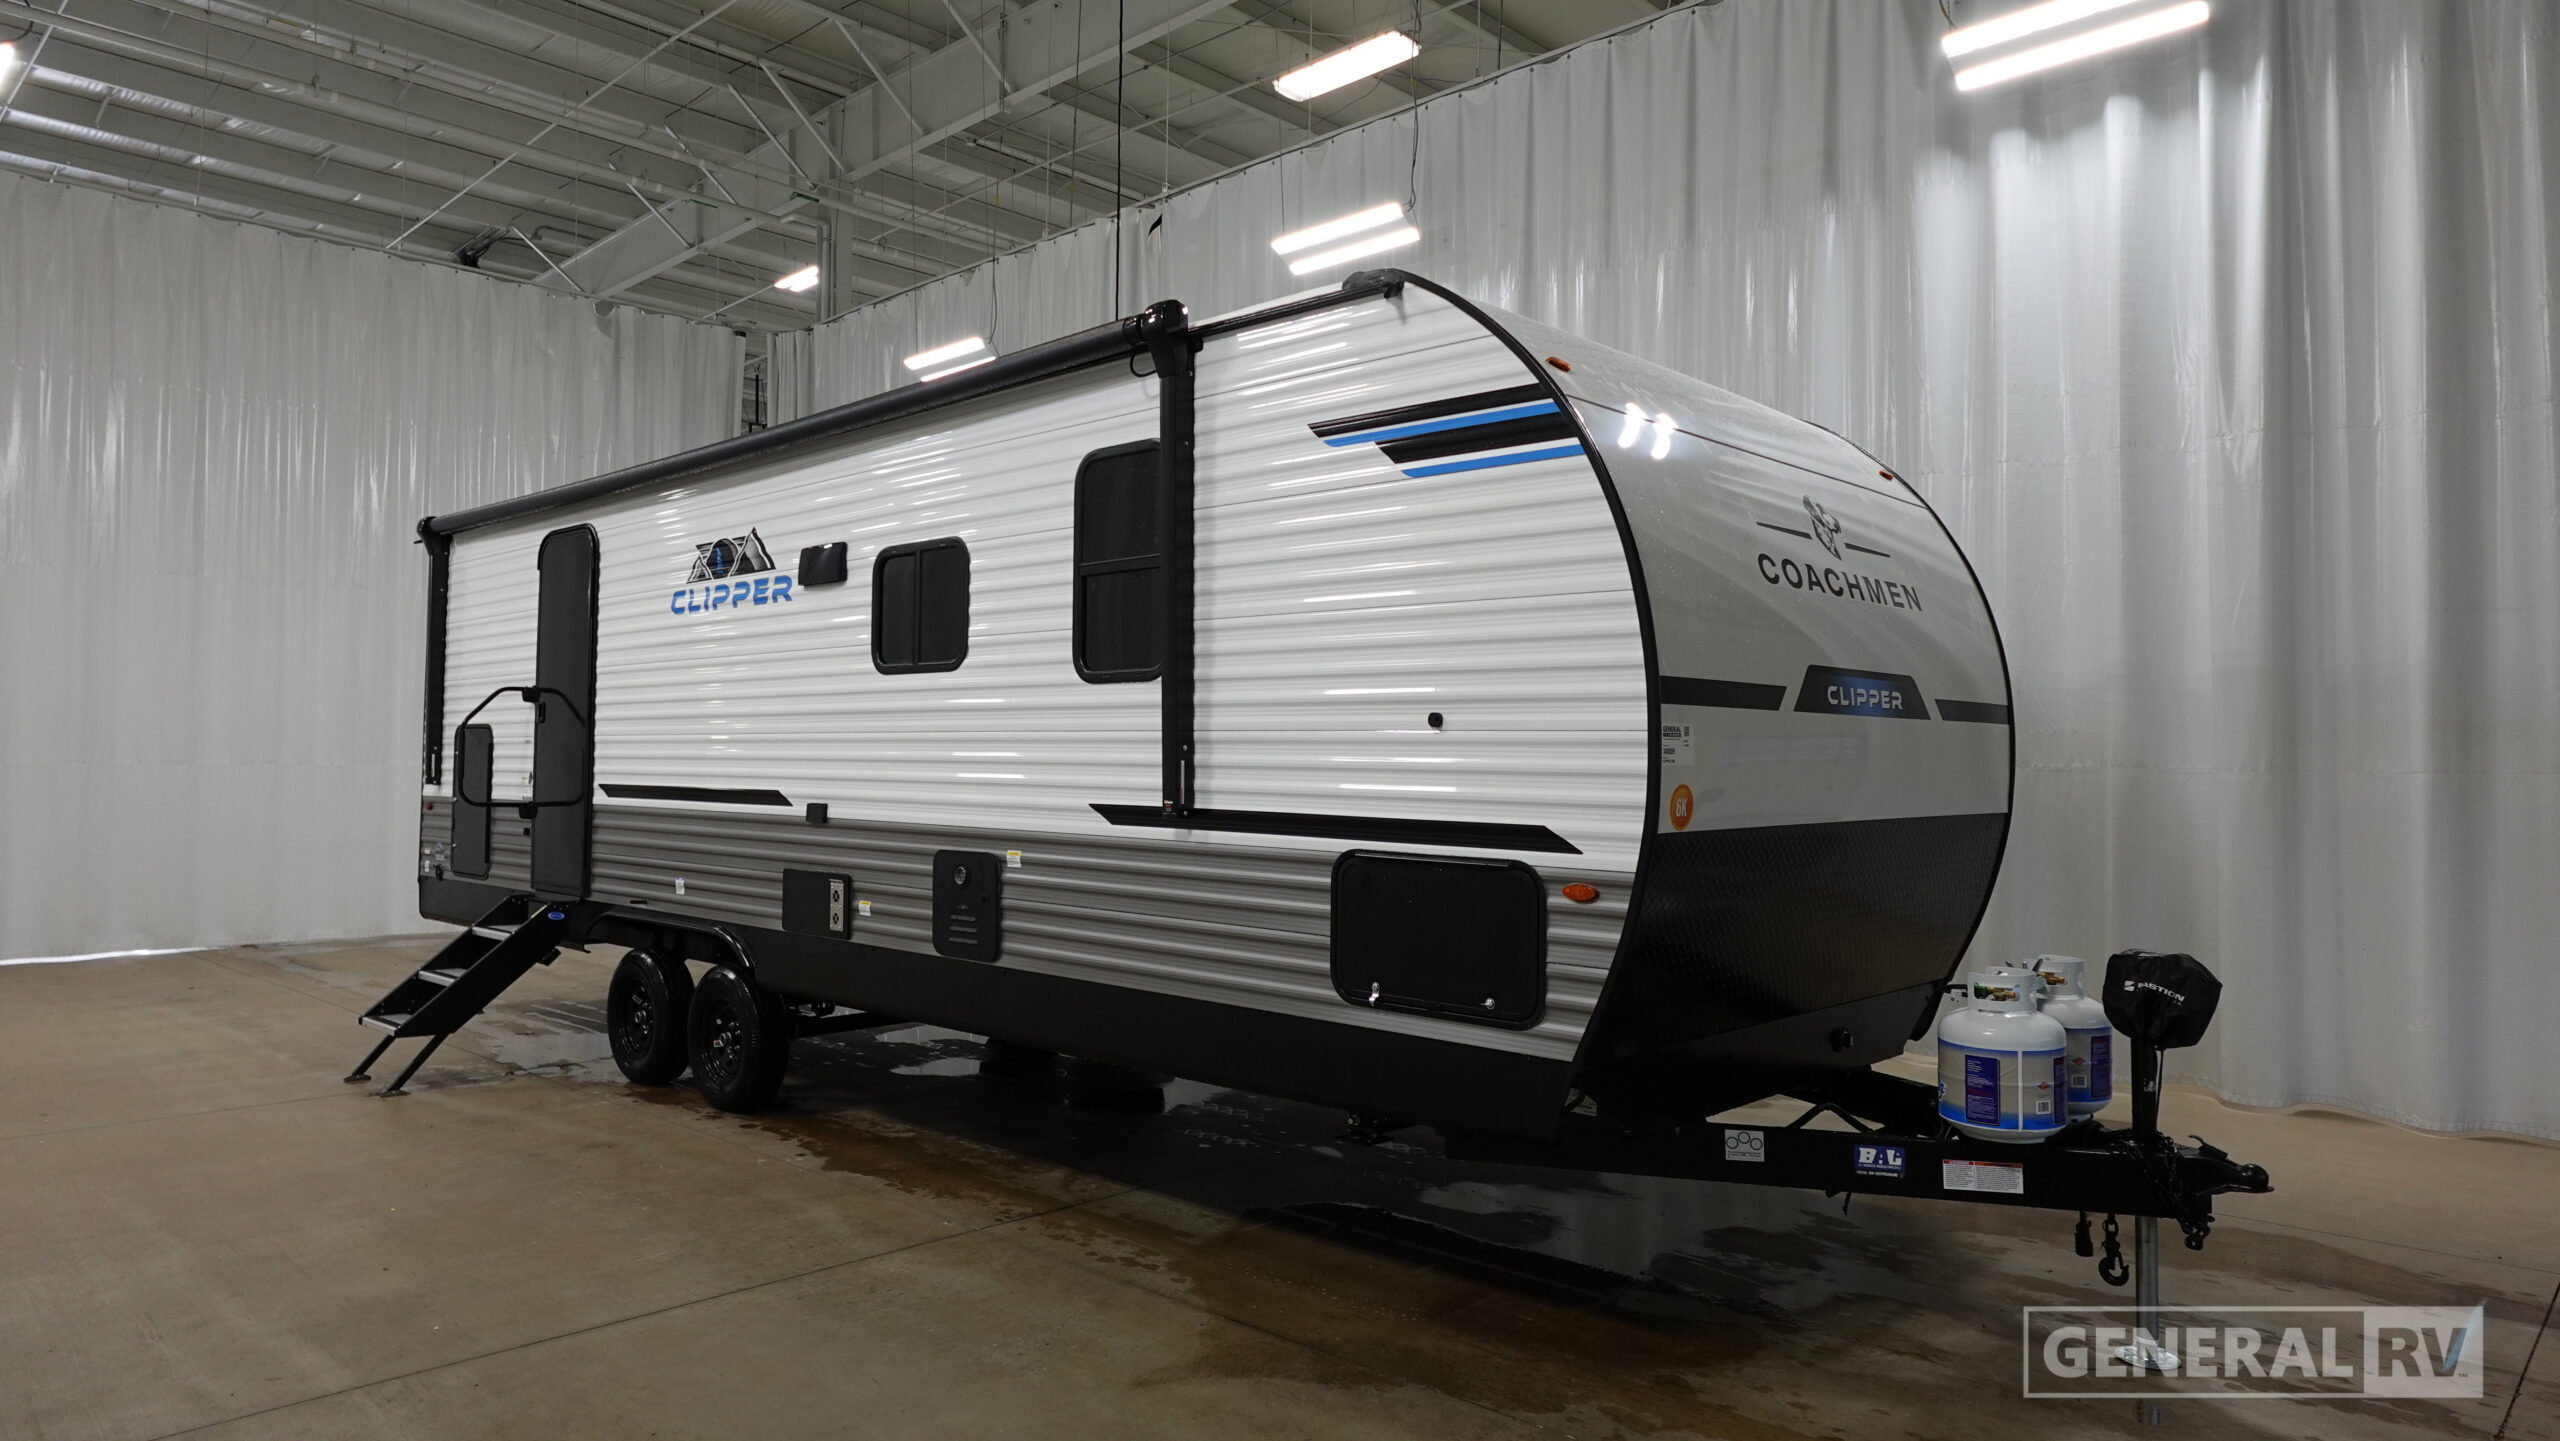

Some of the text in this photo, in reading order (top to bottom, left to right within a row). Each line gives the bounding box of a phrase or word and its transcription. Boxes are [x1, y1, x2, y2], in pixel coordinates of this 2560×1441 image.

[670, 574, 793, 616] CLIPPER
[1757, 553, 1922, 612] COACHMEN
[1827, 685, 1904, 711] CLIPPER
[1676, 798, 1688, 817] 6K
[1859, 1147, 1902, 1166] BAL
